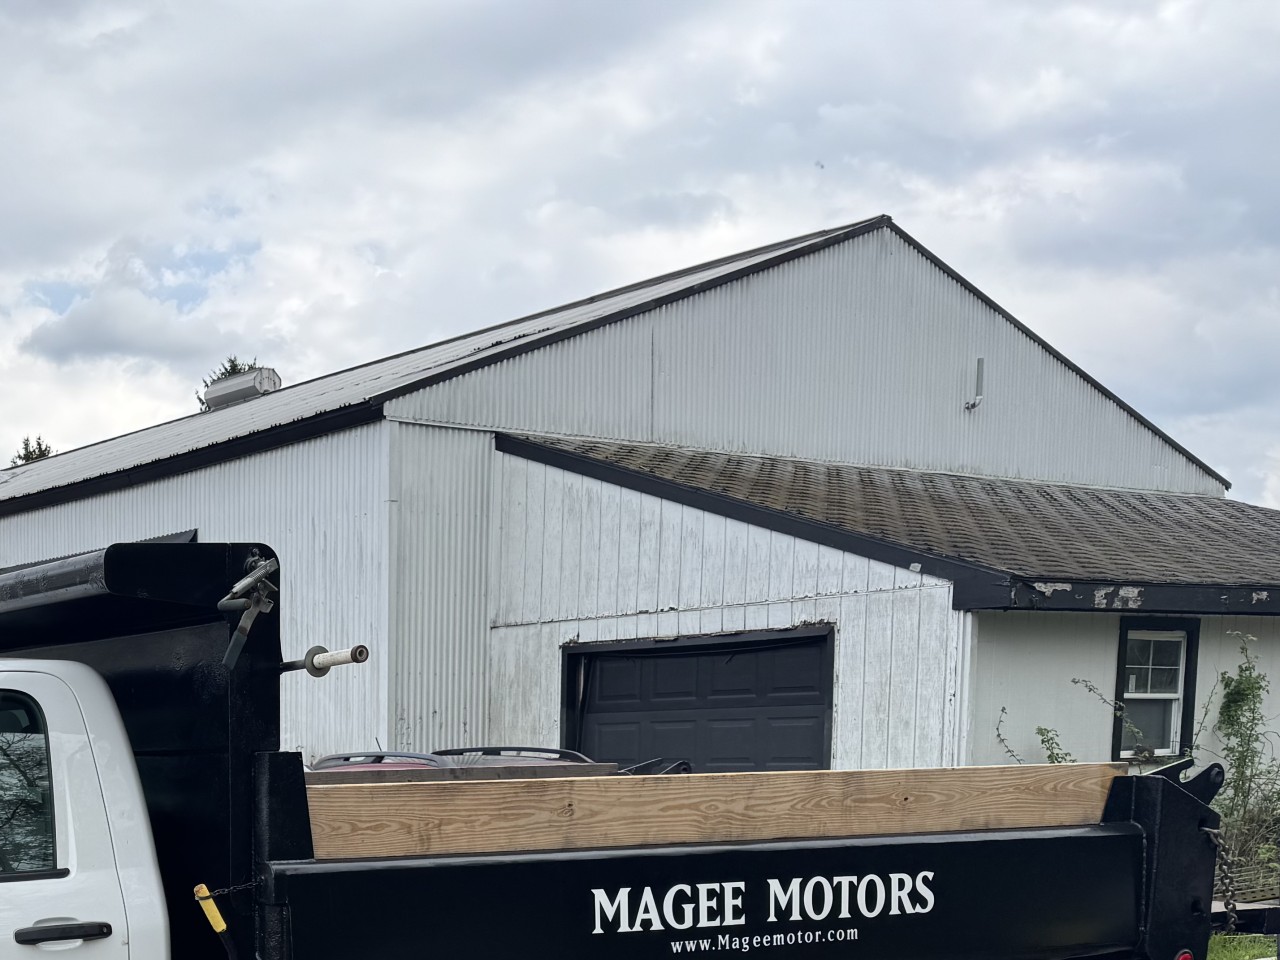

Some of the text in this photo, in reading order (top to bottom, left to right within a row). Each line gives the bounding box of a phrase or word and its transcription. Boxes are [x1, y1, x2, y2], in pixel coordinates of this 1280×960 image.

[591, 871, 935, 934] MAGEE MOTORS
[670, 926, 859, 954] www.Mageemotor.com
